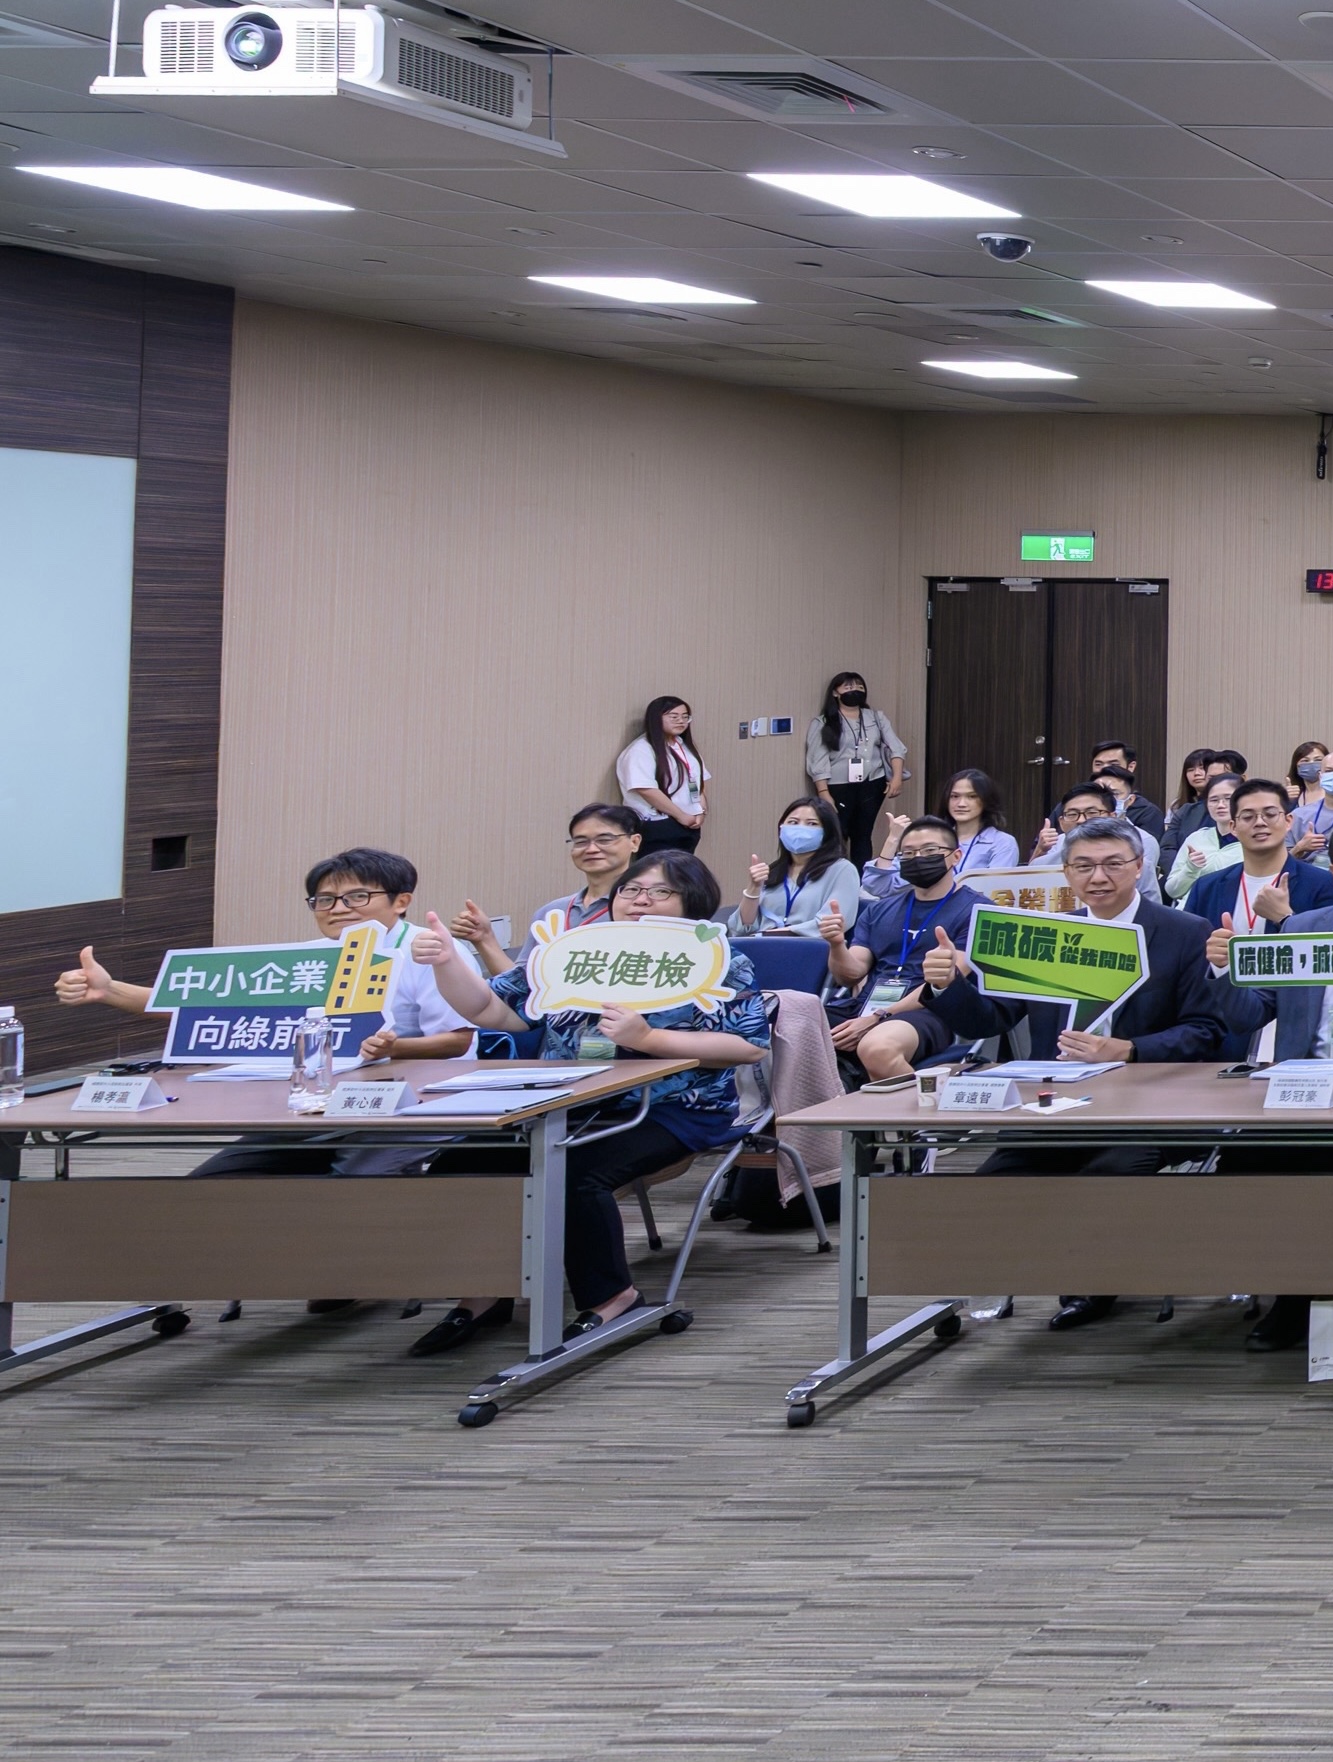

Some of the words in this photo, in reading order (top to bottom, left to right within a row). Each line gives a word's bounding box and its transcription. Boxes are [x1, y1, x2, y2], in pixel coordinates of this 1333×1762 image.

[978, 887, 1084, 913] 金榮耀
[978, 919, 1058, 963] 減碳
[1060, 945, 1137, 973] 從我開始
[168, 959, 329, 1000] 中小企業
[563, 950, 696, 988] 碳健檢
